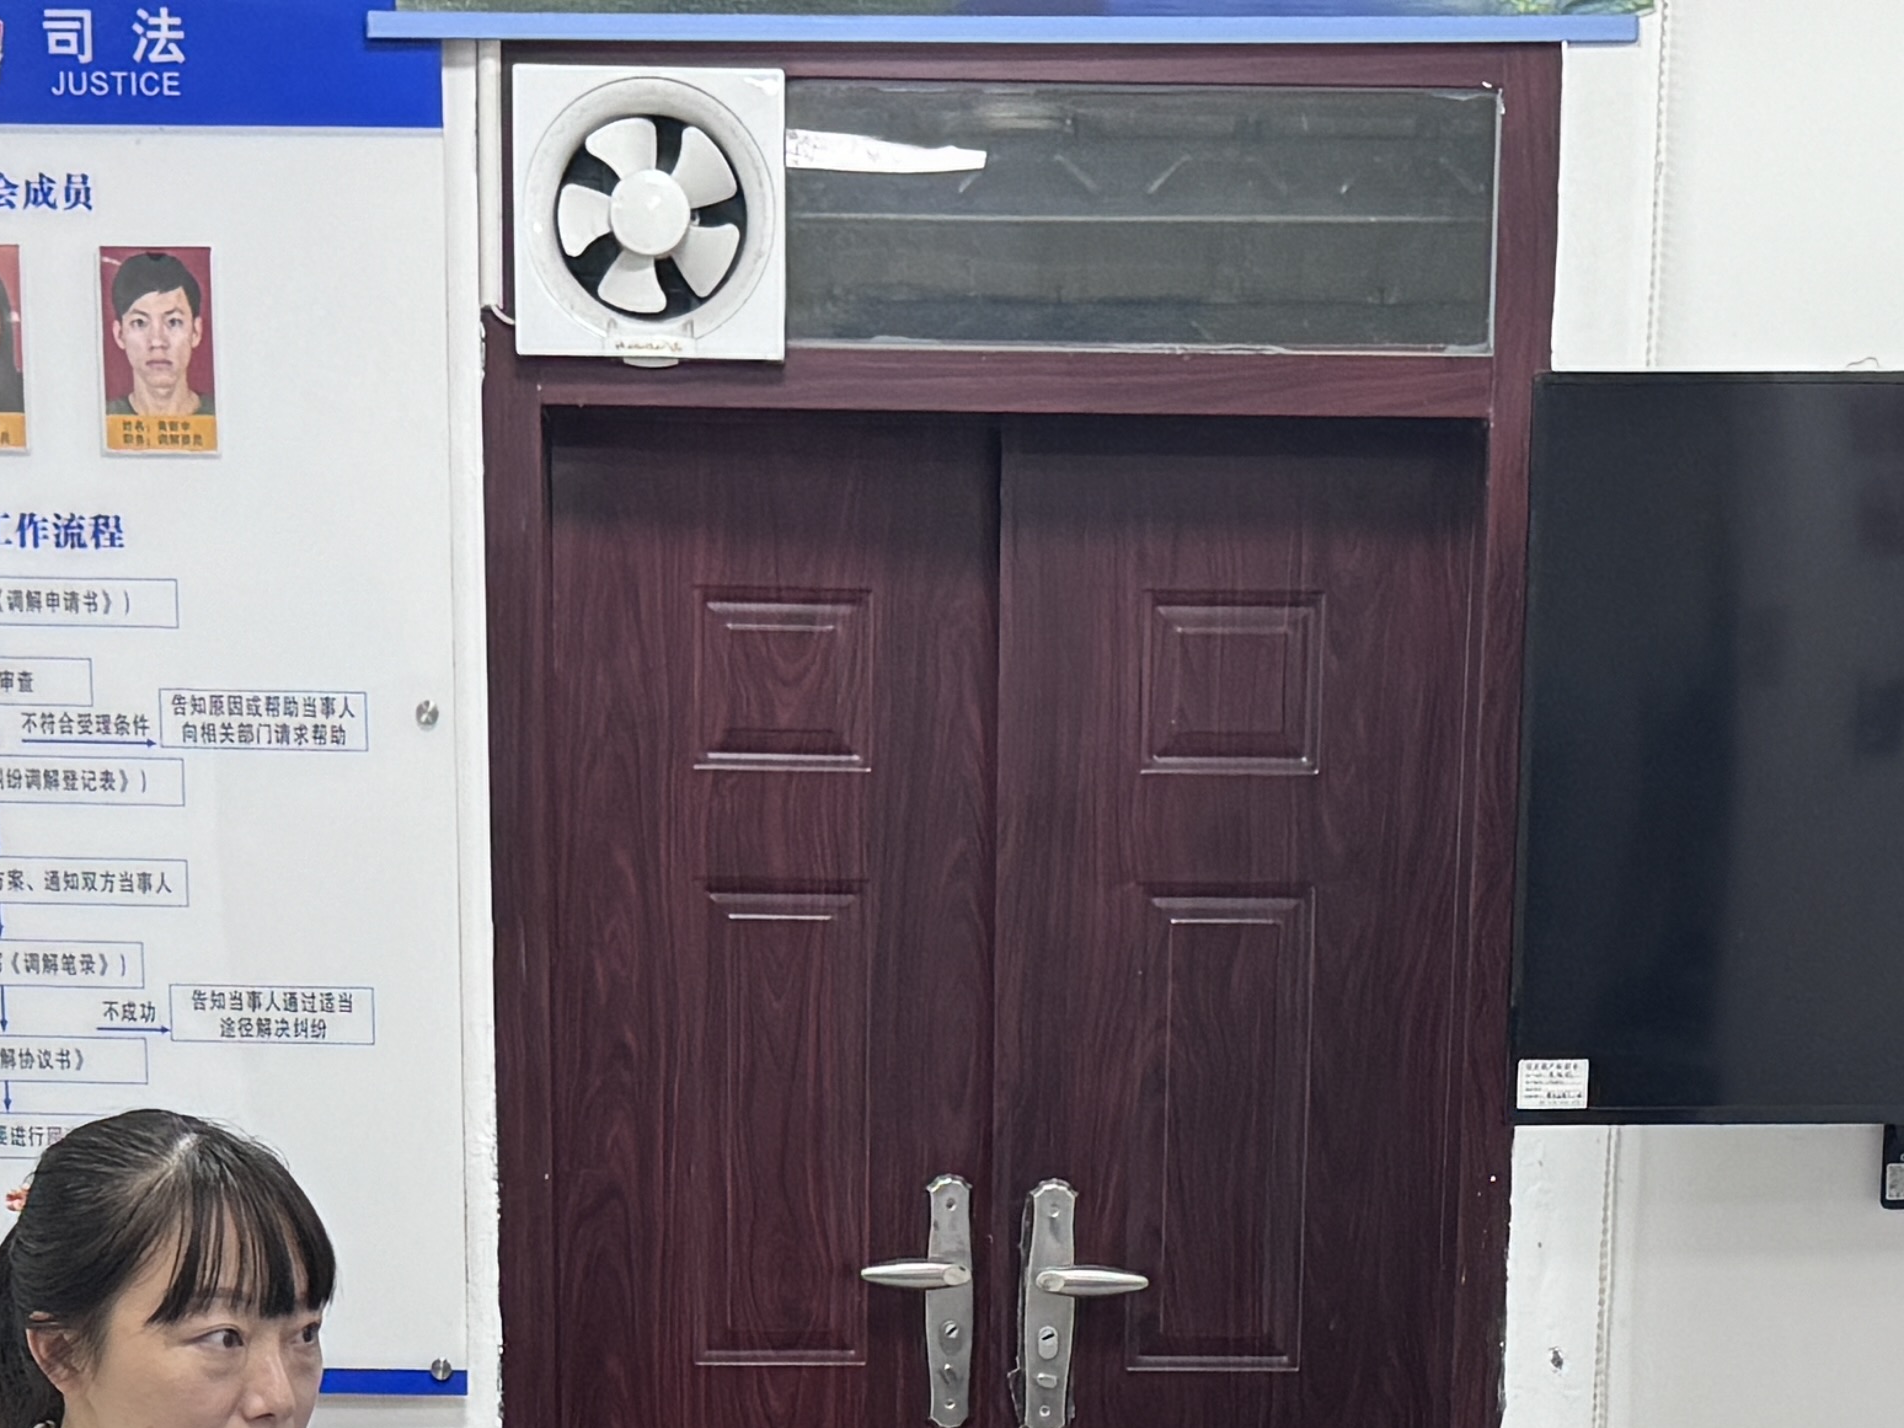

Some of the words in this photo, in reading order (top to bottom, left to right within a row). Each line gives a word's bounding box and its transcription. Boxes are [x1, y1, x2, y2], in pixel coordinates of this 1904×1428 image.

[42, 8, 186, 65] 司法
[51, 71, 182, 97] JUSTICE
[171, 693, 356, 720] 告知原因或帮助当事人
[21, 711, 151, 737] 不符合受理条件
[182, 722, 346, 746] 向相关部门请求帮助
[103, 1001, 156, 1023] 不成功
[191, 990, 354, 1014] 告知当事人通过适当
[218, 1016, 328, 1040] 途径解决纠纷
